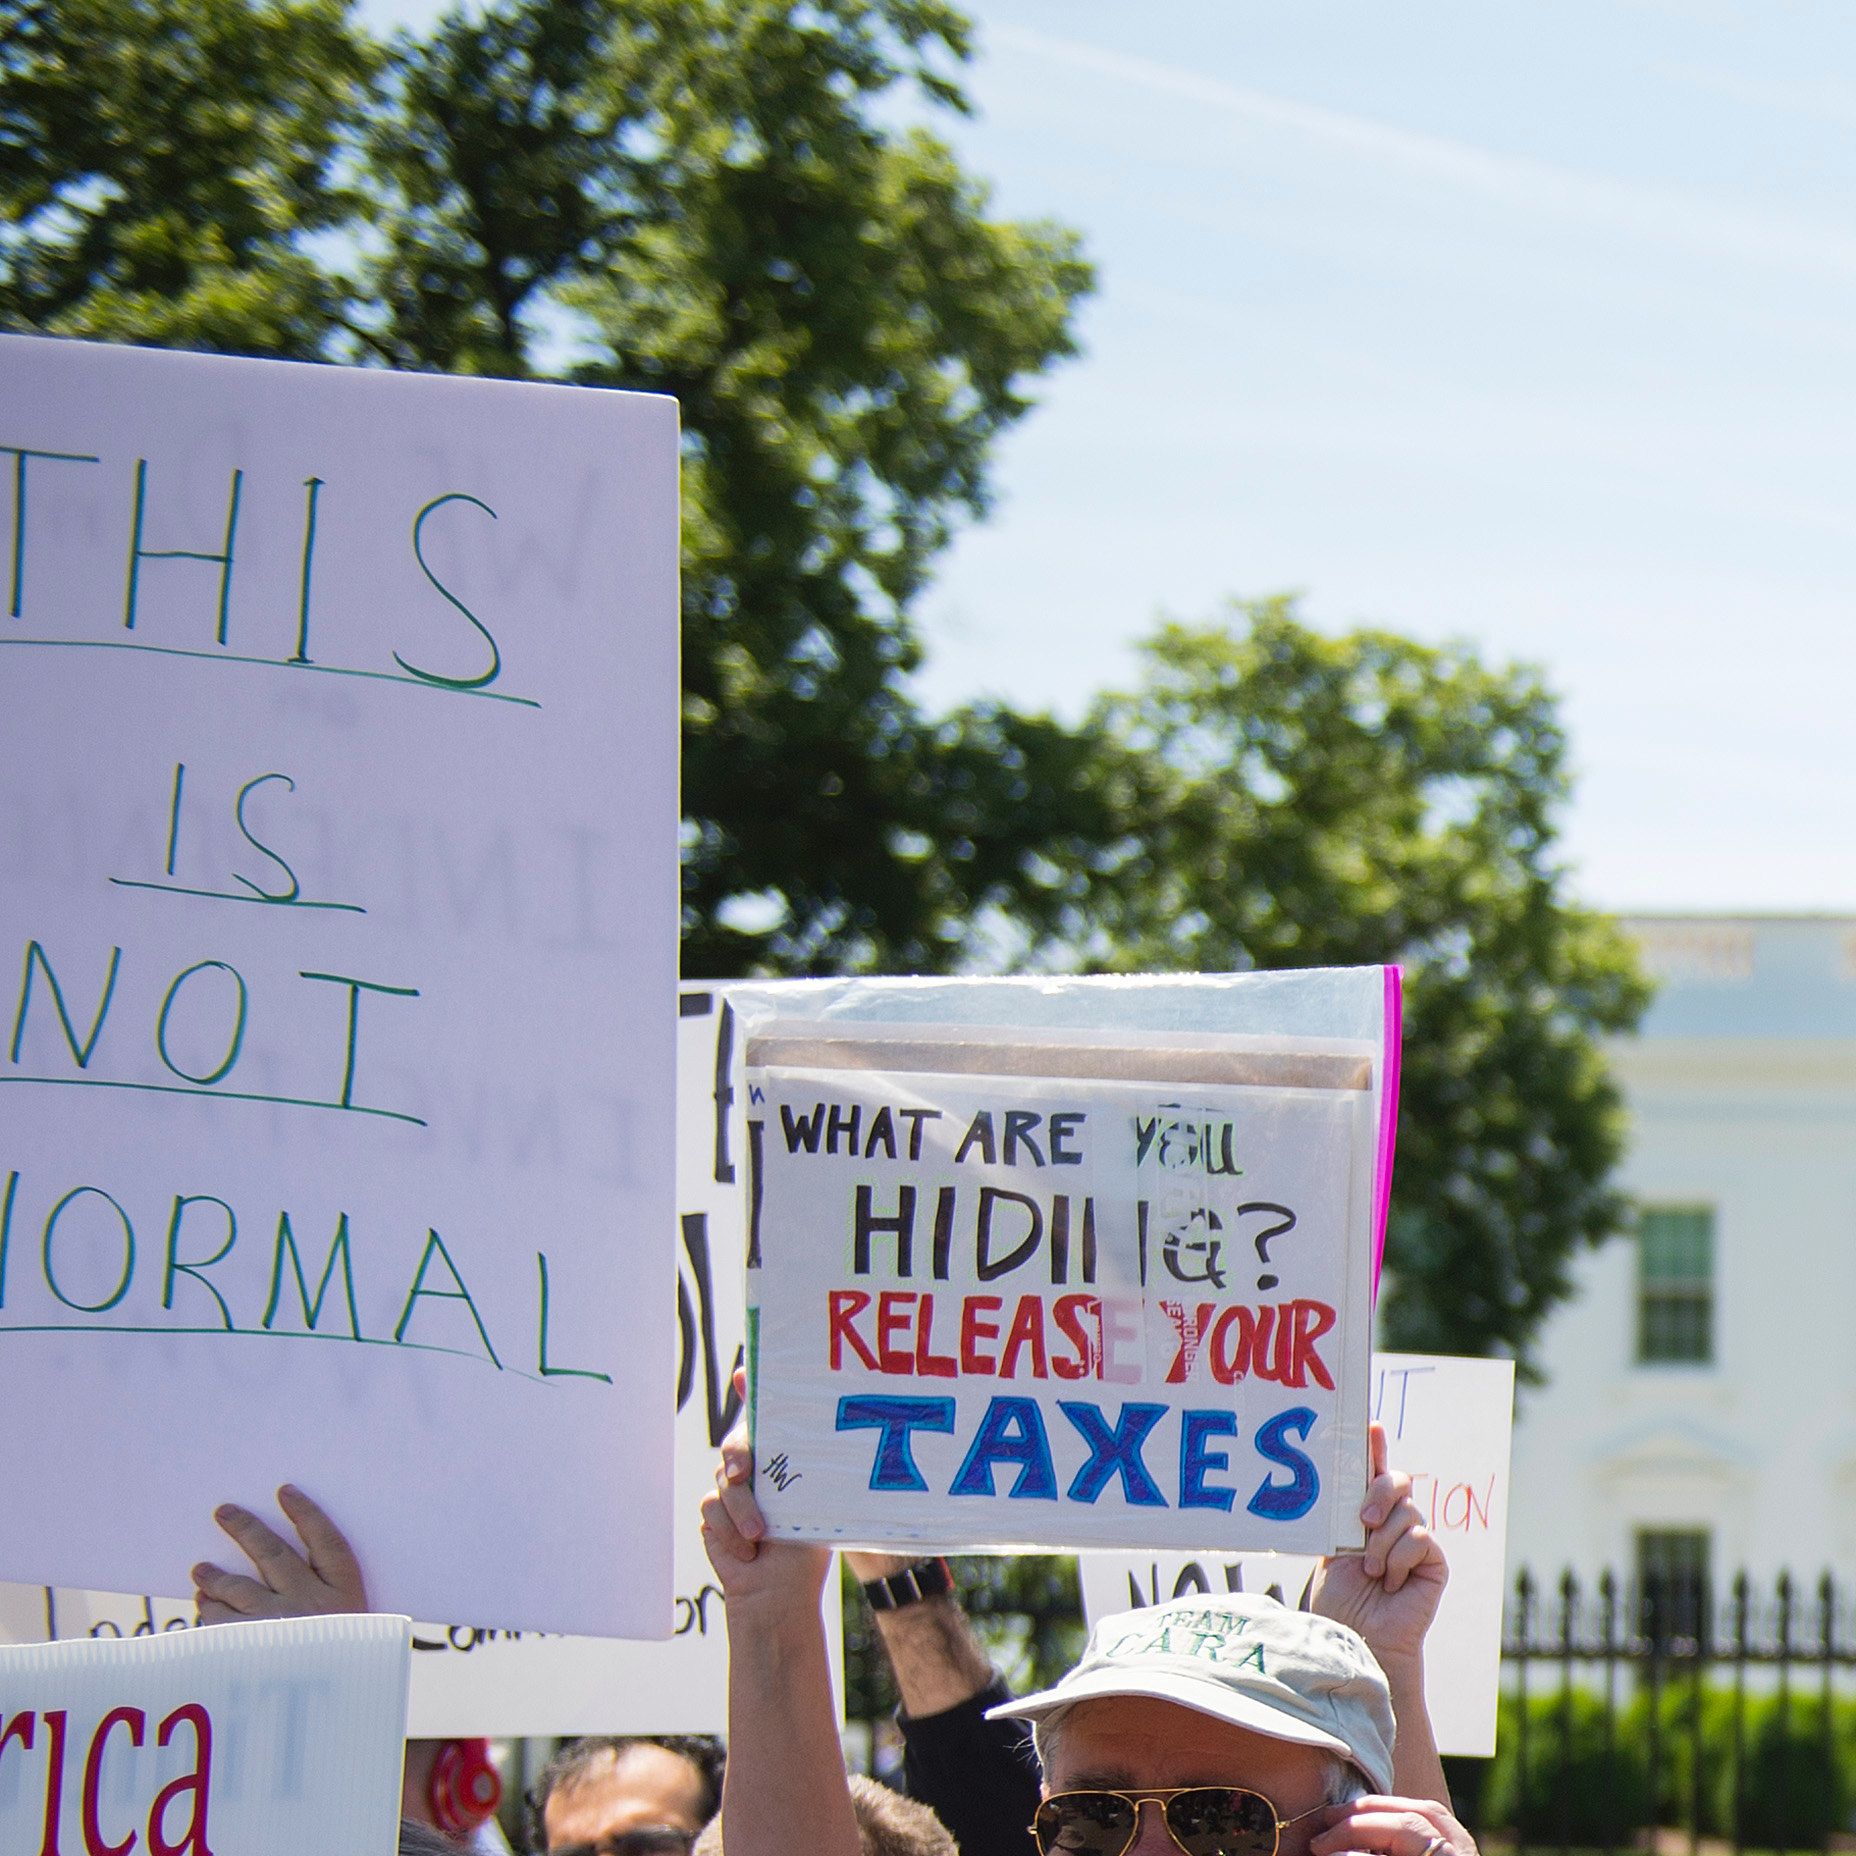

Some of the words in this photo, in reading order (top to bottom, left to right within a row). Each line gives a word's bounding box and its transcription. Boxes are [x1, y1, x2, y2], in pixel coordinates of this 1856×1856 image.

[0, 447, 501, 690] THIS
[166, 762, 300, 902] IS
[10, 939, 420, 1109] NOT
[780, 1103, 944, 1161] WHAT
[955, 1110, 1087, 1168] ARE
[828, 1289, 1143, 1386] RELEASE
[1157, 1297, 1337, 1392] YOUR
[834, 1394, 1320, 1523] TAXES
[1106, 1626, 1267, 1675] CARA
[1157, 1609, 1251, 1636] TEAM
